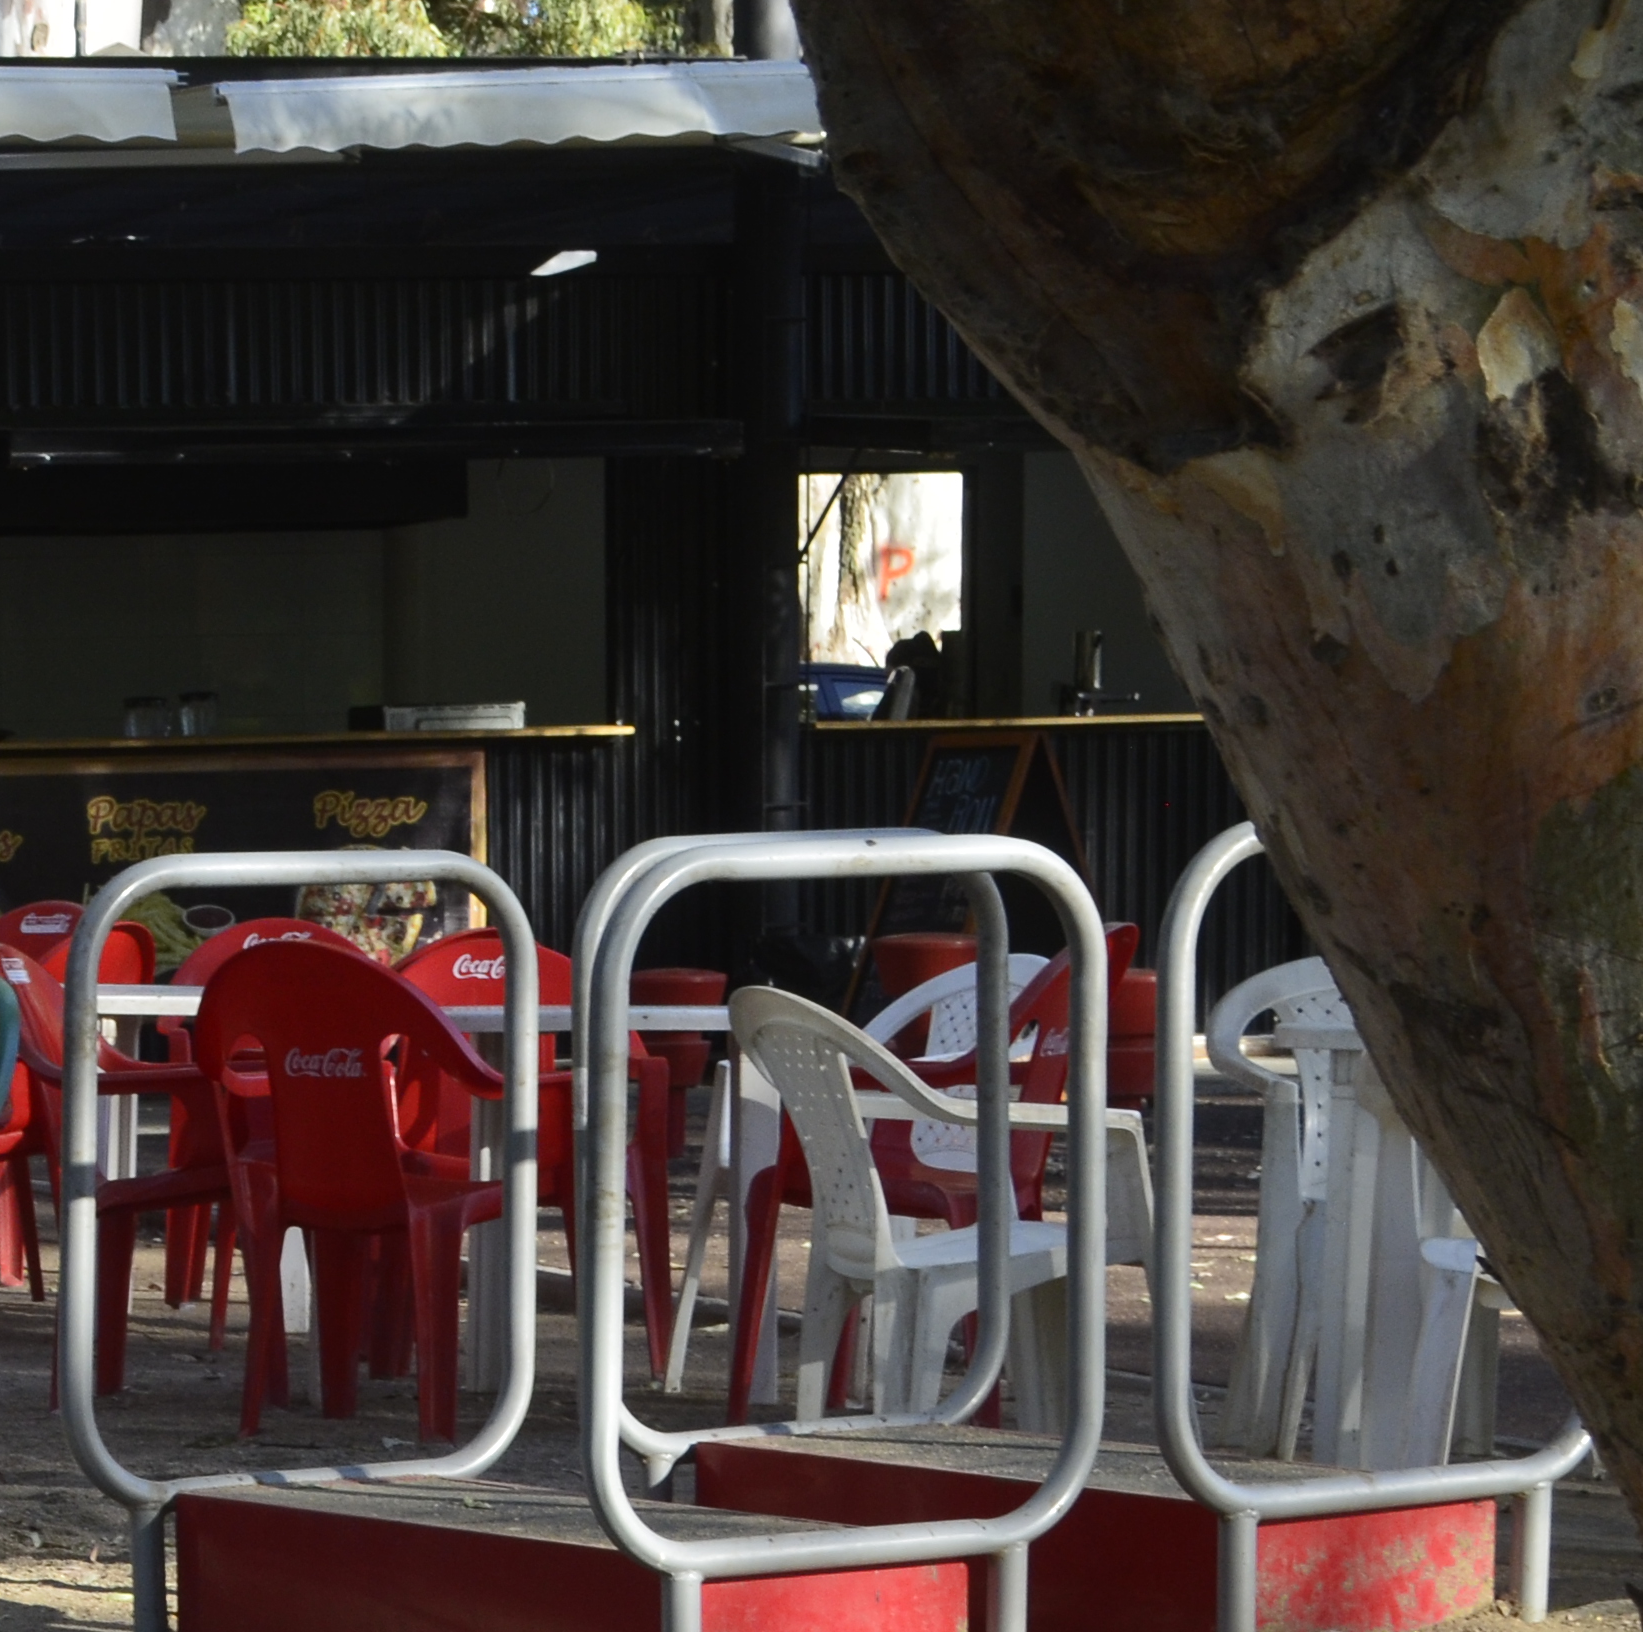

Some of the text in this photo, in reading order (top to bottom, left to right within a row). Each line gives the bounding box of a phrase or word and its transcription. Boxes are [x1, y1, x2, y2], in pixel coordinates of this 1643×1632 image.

[878, 546, 915, 602] P
[86, 796, 207, 842] Papas
[313, 789, 428, 838] Pizza
[284, 1047, 367, 1078] Coca-Cola
